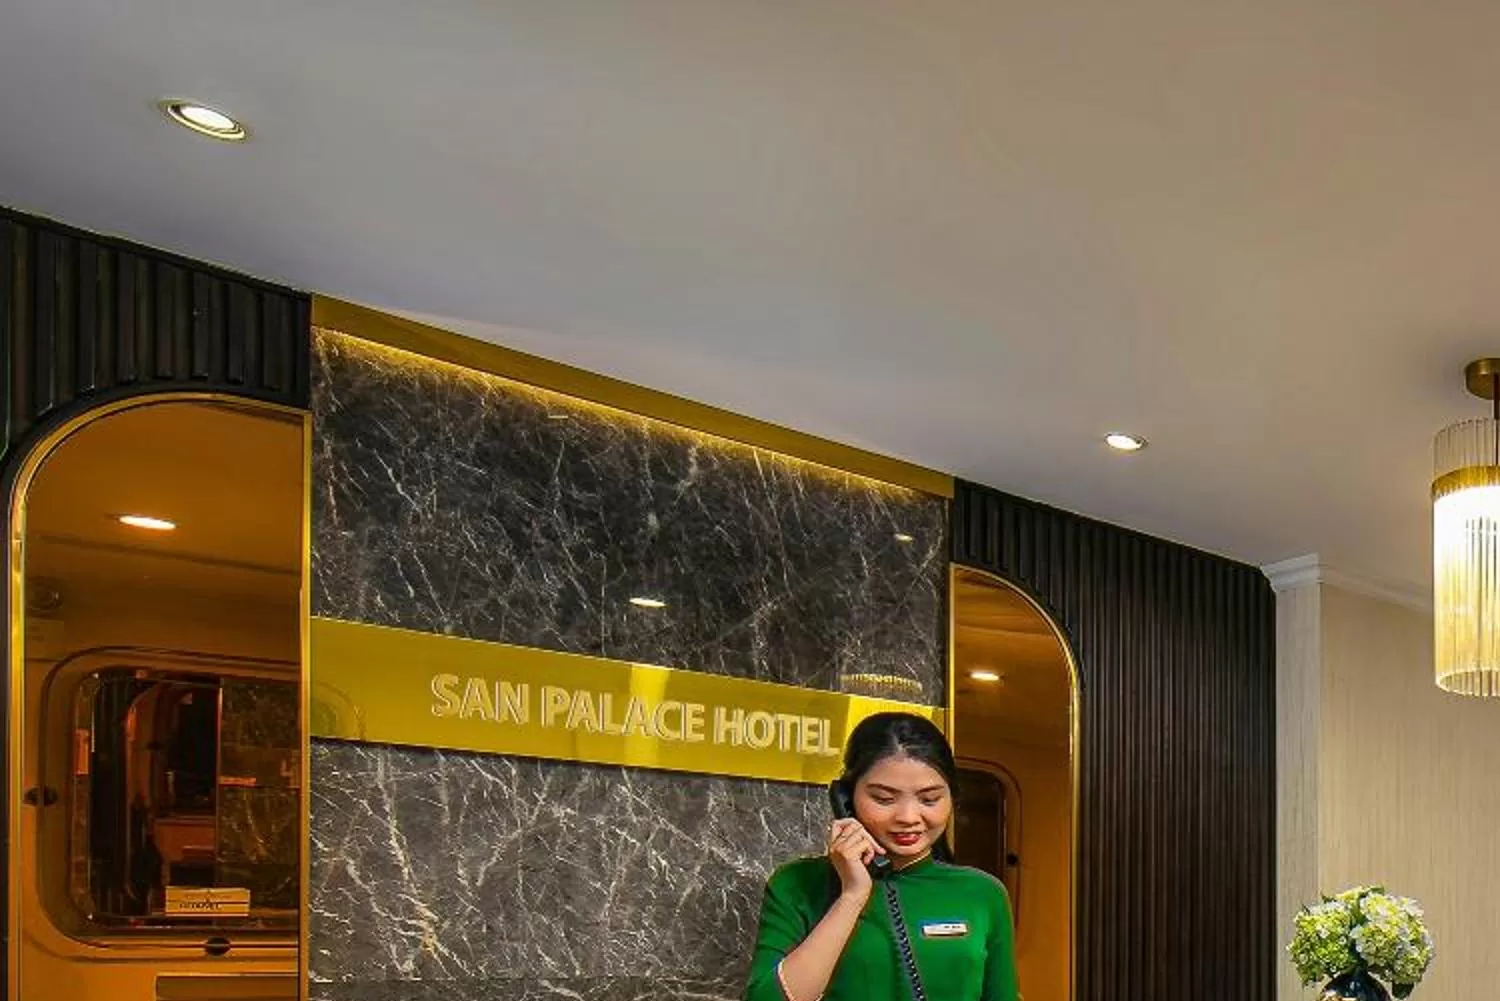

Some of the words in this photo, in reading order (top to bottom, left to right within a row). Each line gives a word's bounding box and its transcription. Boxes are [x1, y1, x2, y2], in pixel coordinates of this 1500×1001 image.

[431, 673, 530, 725] SAN
[541, 685, 705, 742] PALACE
[713, 706, 840, 757] HOTEL
